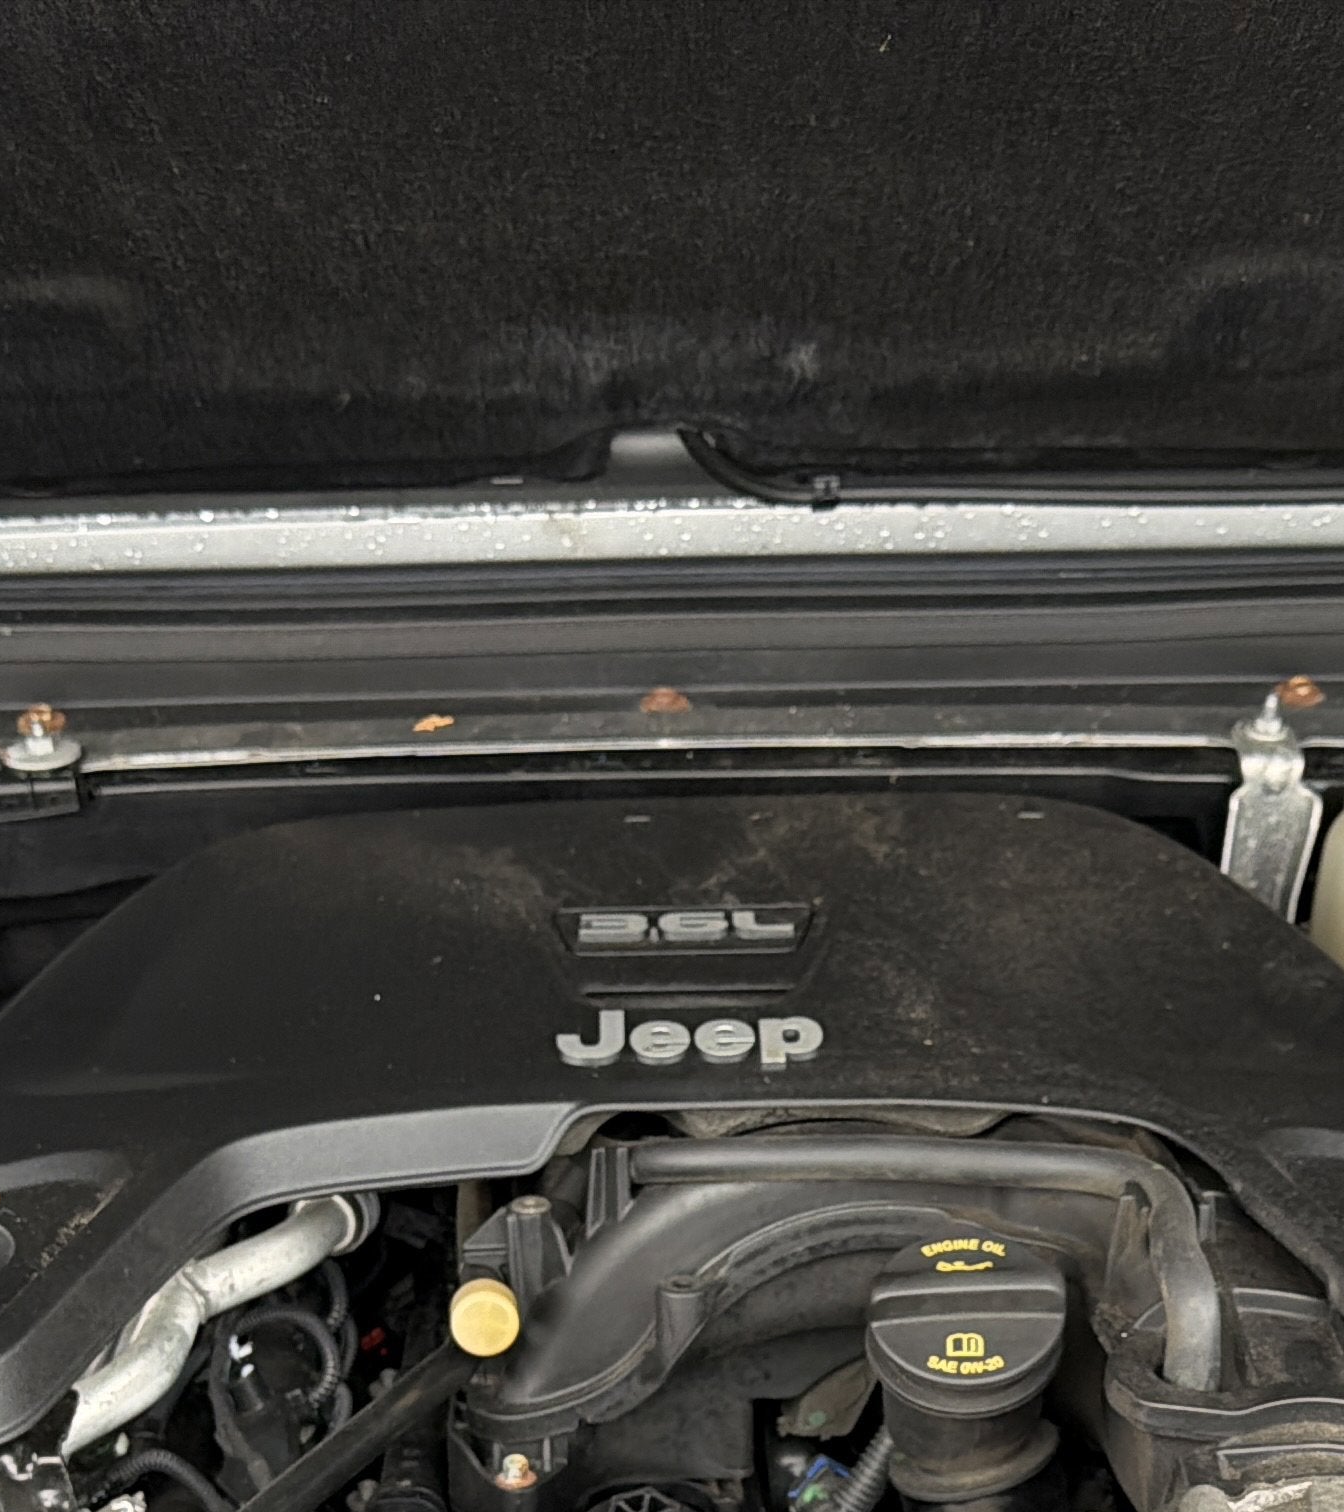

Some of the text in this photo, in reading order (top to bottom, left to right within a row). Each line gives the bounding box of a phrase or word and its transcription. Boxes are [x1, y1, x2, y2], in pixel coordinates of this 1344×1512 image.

[578, 910, 795, 943] 3.6L
[556, 1009, 824, 1070] Jeep
[920, 1238, 1006, 1257] ENGINE OIL
[926, 1355, 1005, 1375] SAE 0W-20
